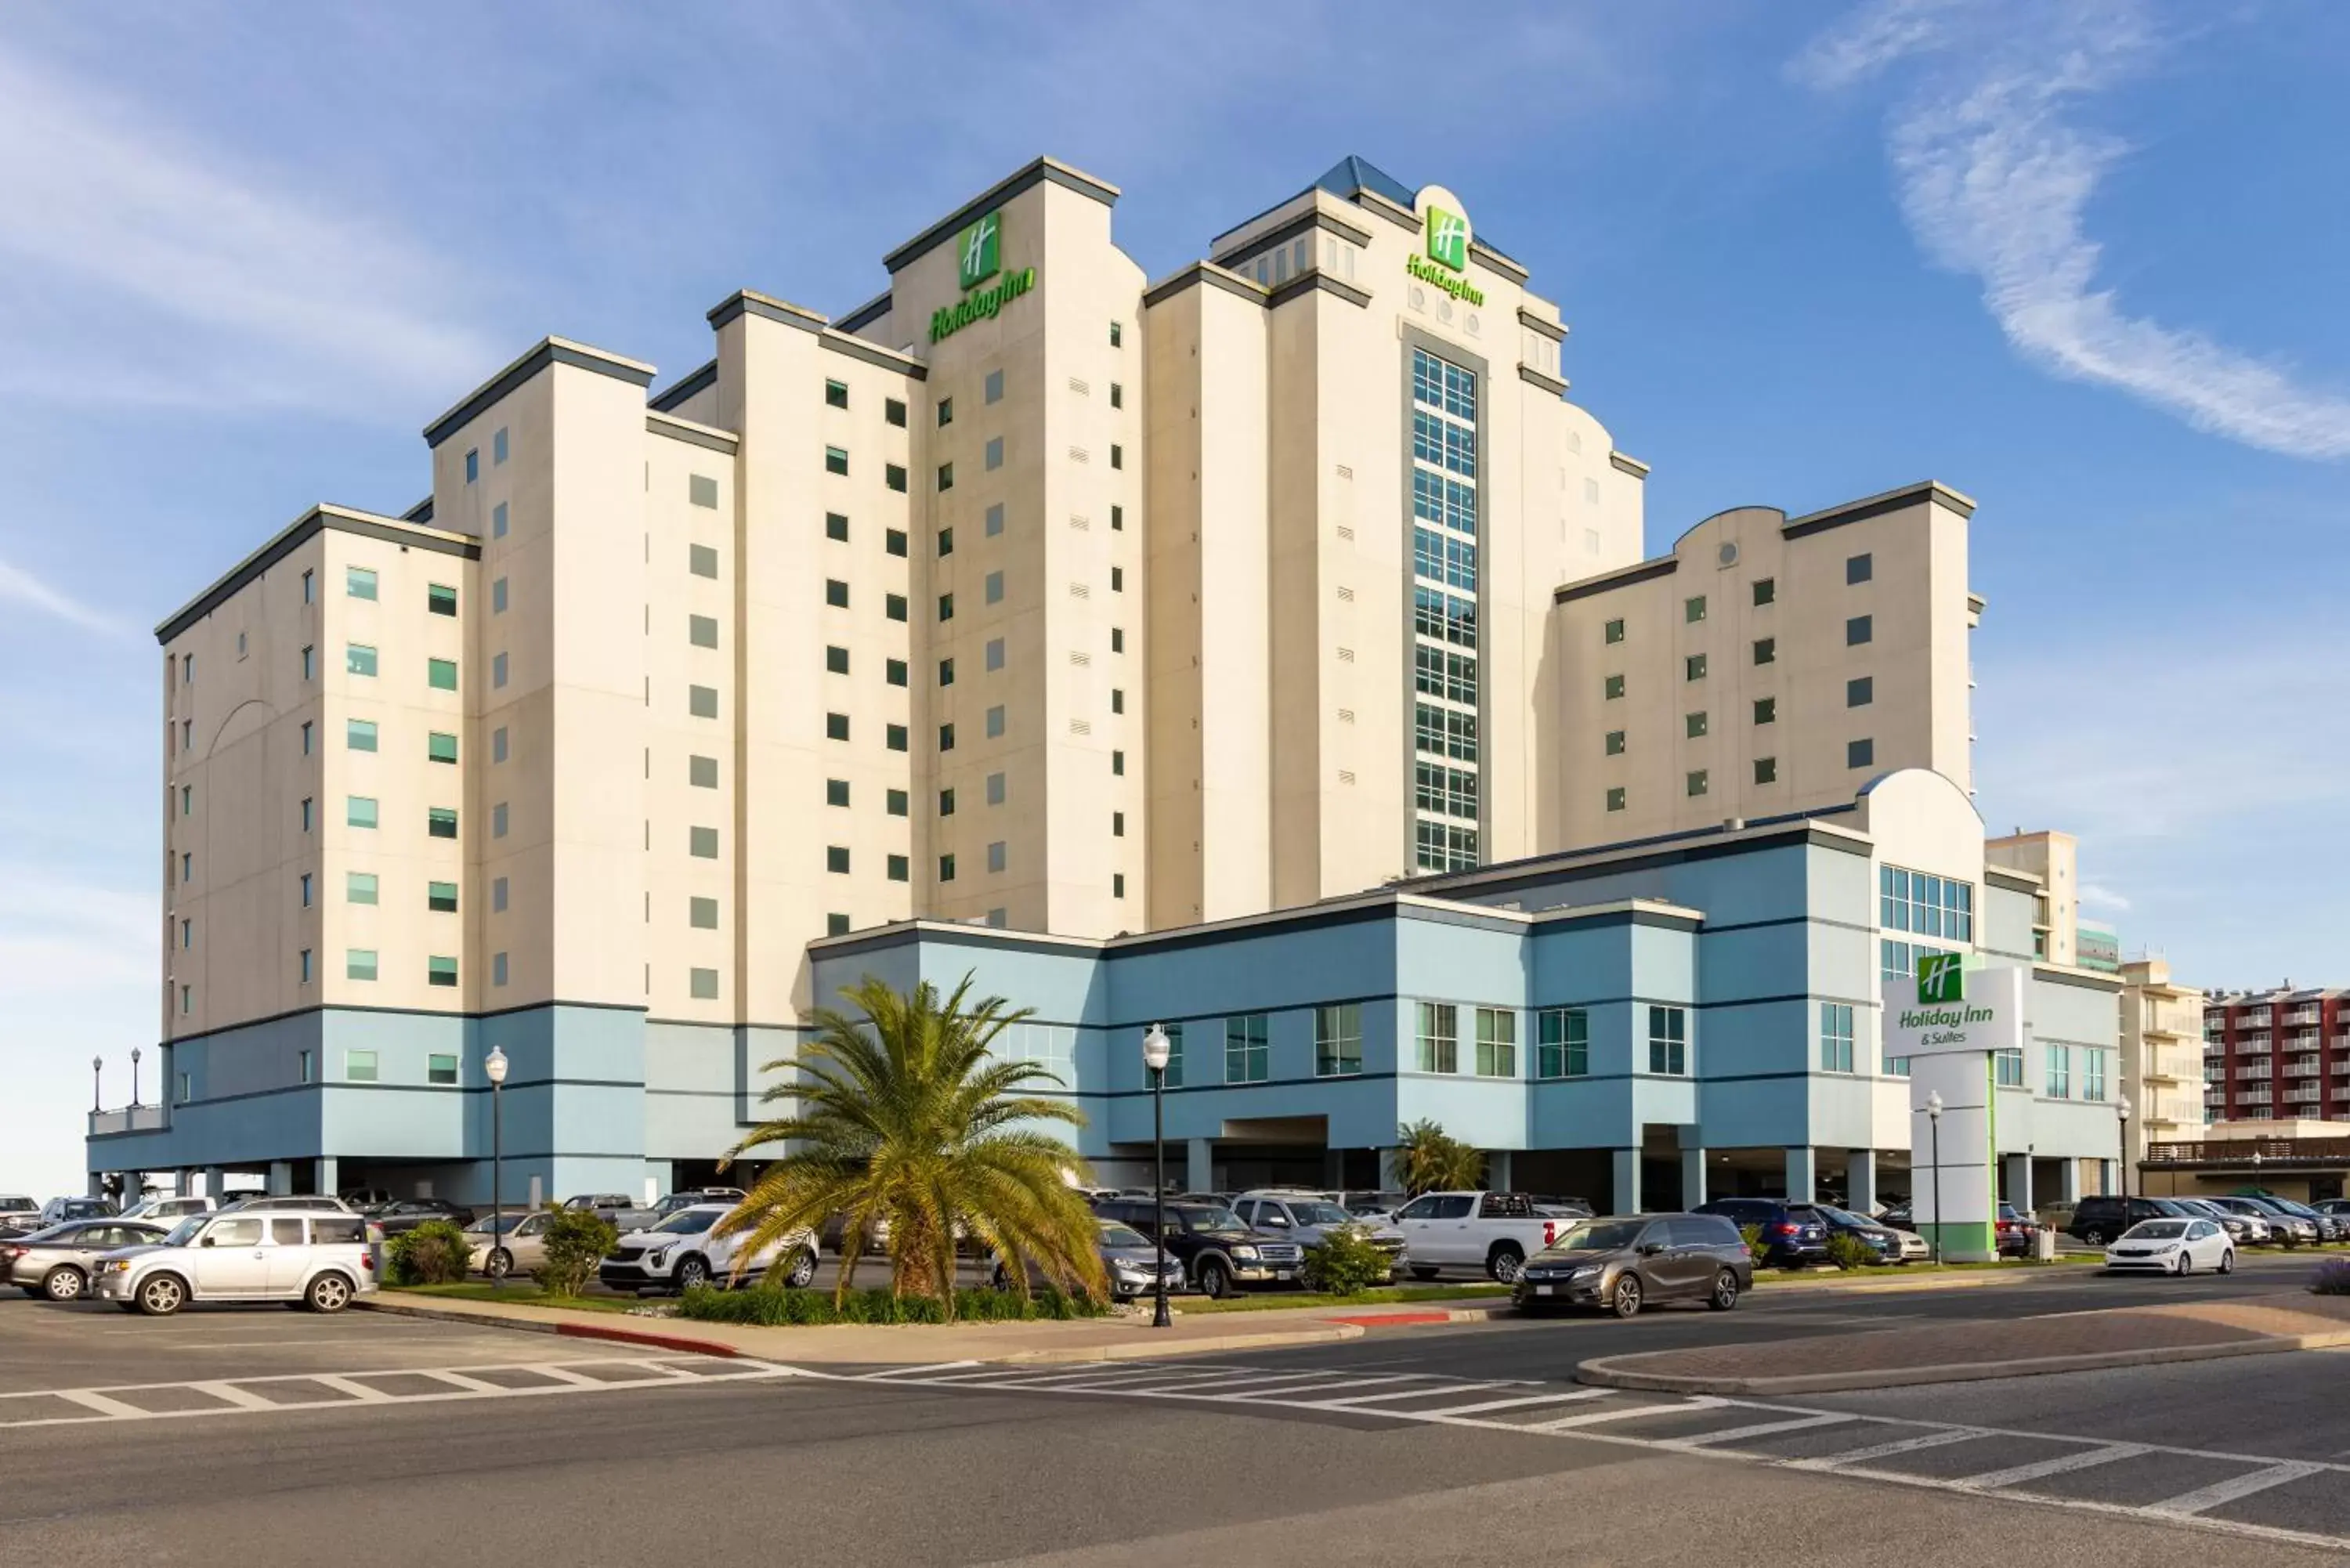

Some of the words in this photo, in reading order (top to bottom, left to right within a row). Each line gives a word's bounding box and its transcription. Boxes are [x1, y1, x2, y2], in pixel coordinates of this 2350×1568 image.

[1406, 253, 1459, 301] Holiday
[1460, 280, 1484, 307] Inn
[929, 288, 1002, 345] Holiday
[1001, 267, 1035, 303] Inn
[1899, 1007, 1961, 1028] Holiday
[1964, 1003, 1993, 1023] Inn
[1922, 1034, 1929, 1045] &
[1932, 1031, 1966, 1045] Suites
